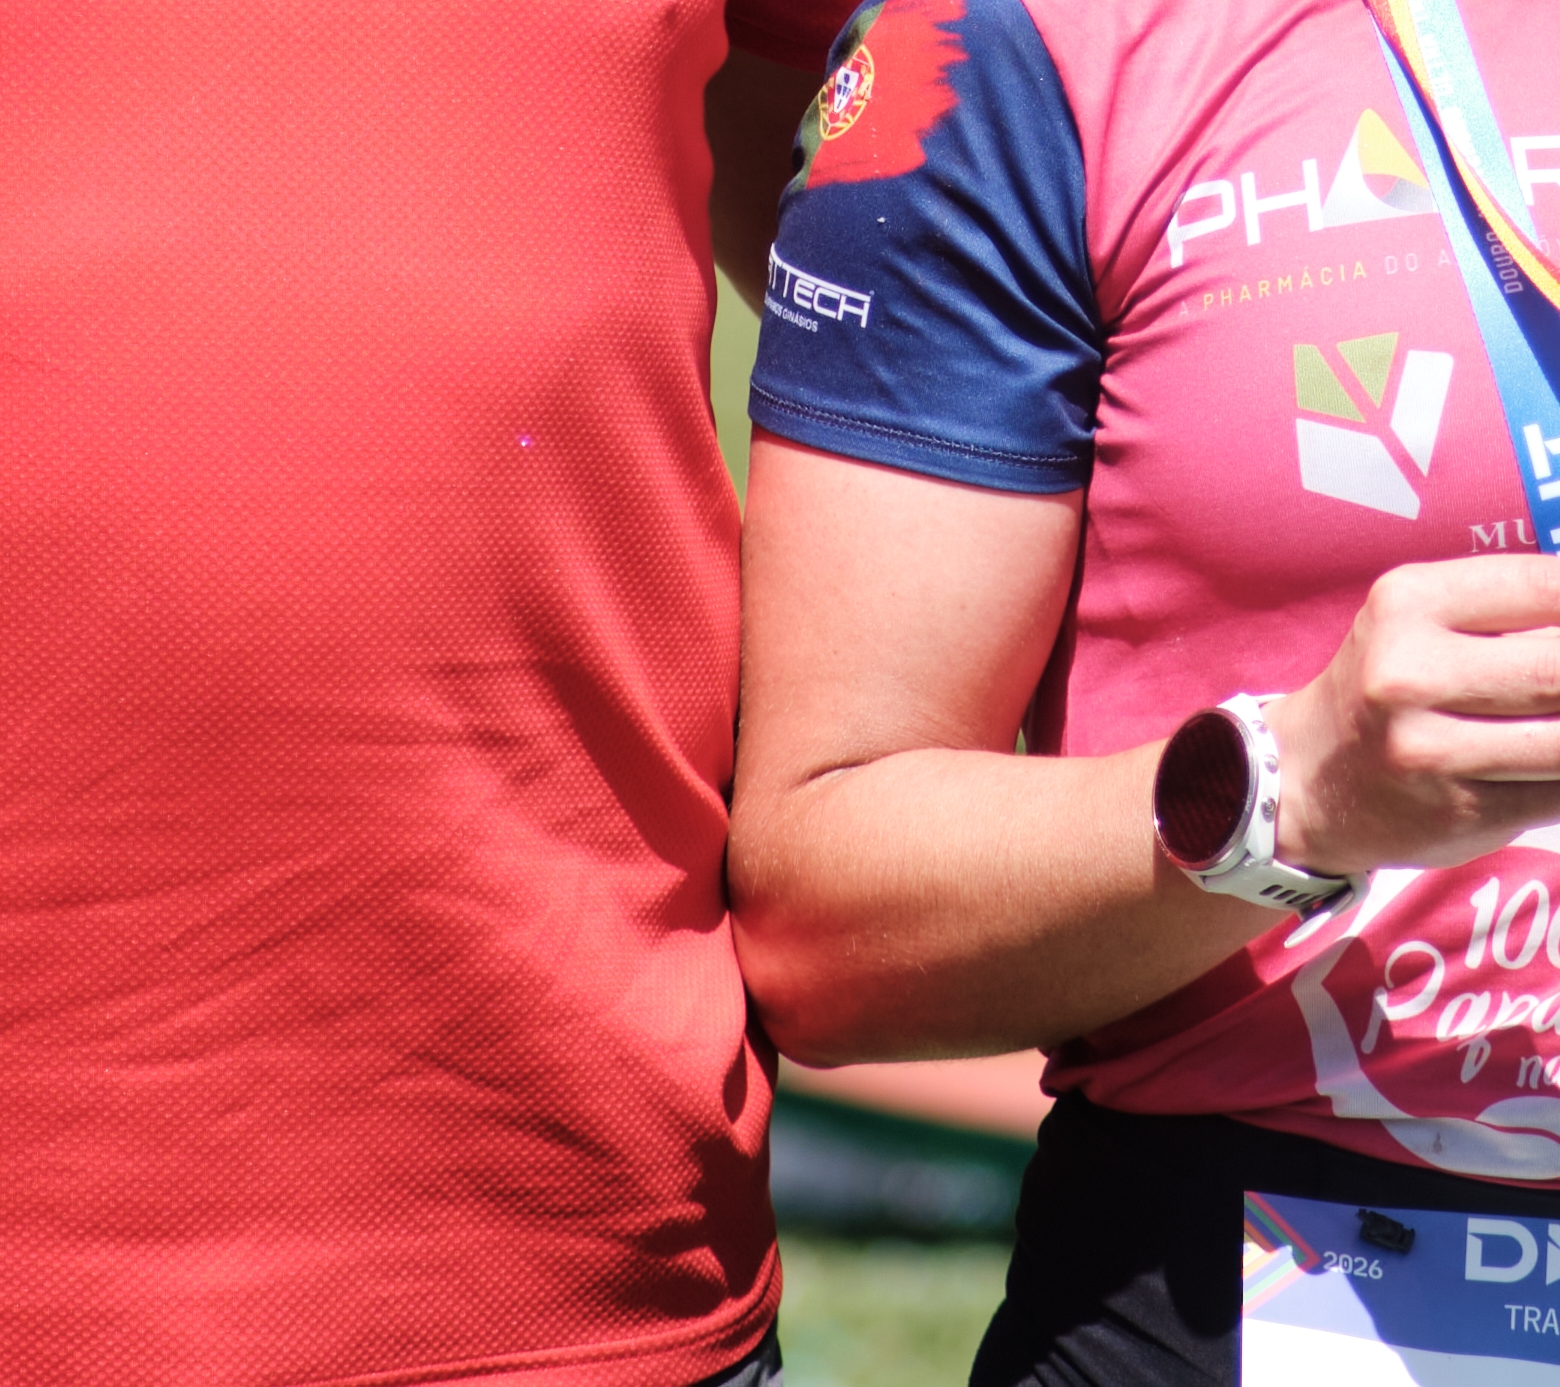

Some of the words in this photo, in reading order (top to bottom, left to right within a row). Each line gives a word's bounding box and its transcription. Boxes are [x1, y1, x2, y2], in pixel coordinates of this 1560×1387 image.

[1202, 259, 1367, 312] PHARMÁCIA
[1384, 251, 1419, 276] DO
[1322, 1249, 1385, 1281] 2026
